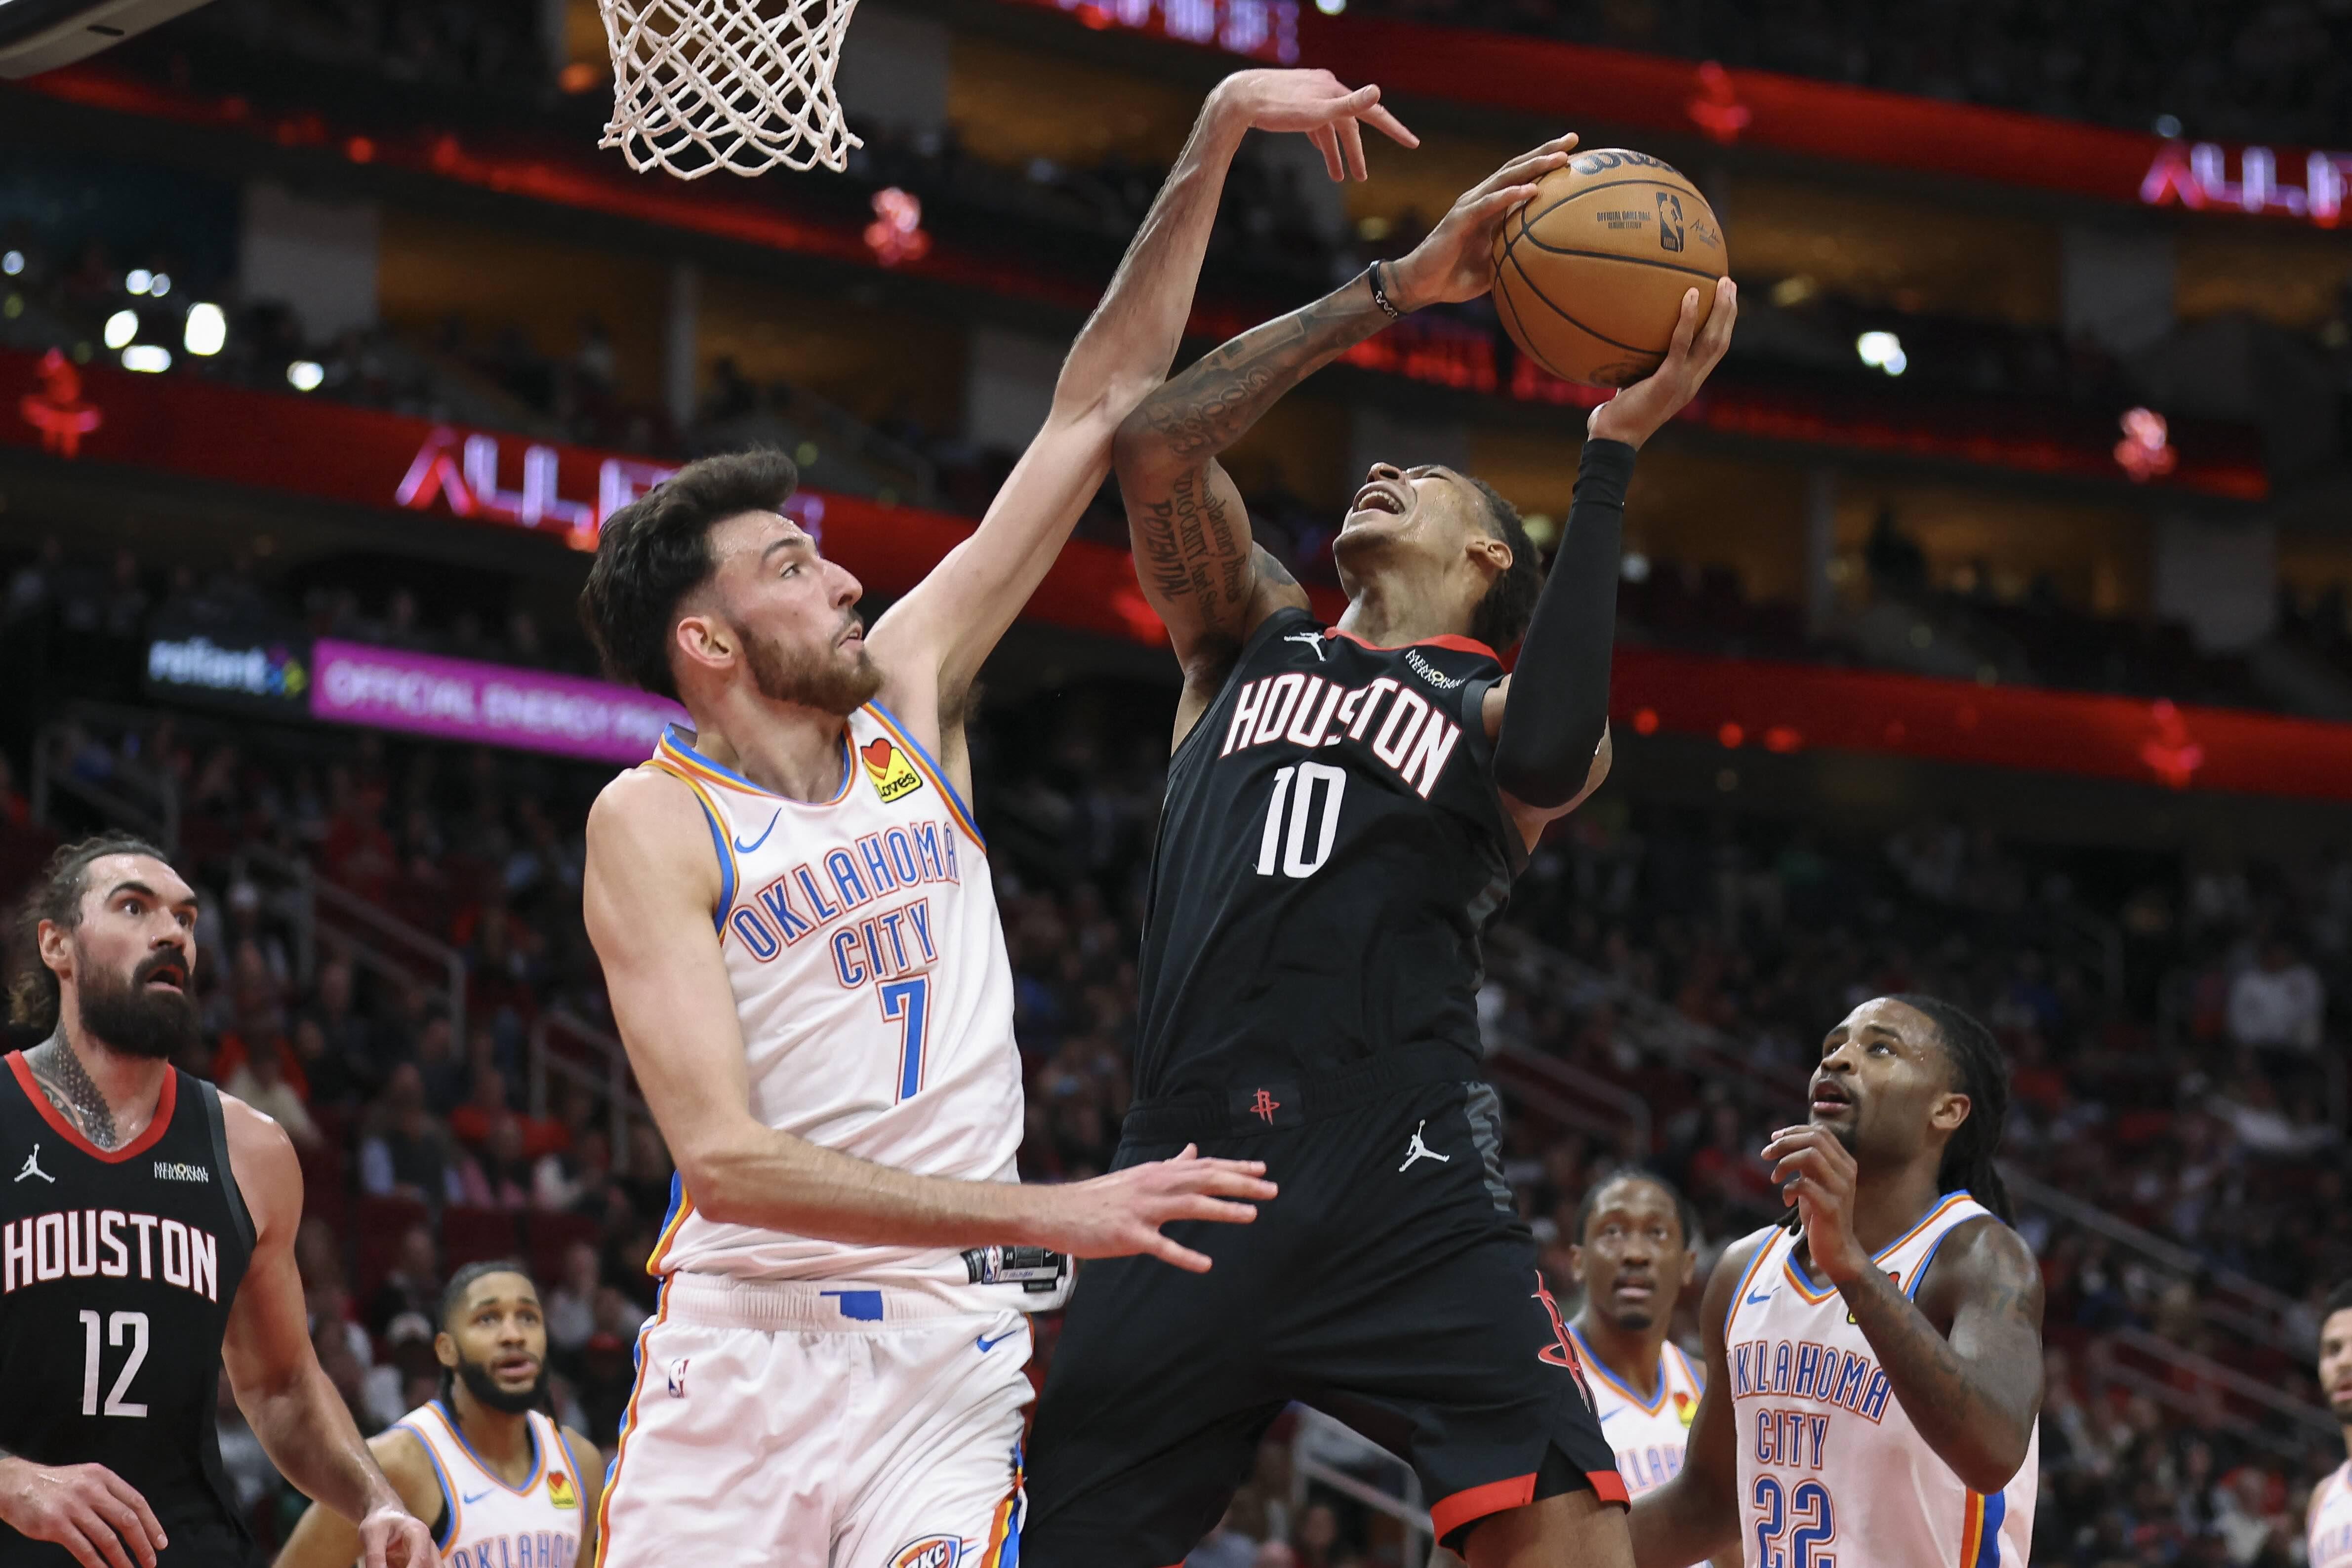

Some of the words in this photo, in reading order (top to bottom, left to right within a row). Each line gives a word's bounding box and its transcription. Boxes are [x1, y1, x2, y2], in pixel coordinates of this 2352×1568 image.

[1219, 673, 1462, 800] HOUSTON
[1256, 761, 1347, 879] 10
[730, 821, 961, 963] OKLAHOMA
[830, 898, 938, 990] CITY
[876, 973, 932, 1105] 7
[2, 1209, 218, 1304] HOUSTON
[79, 1309, 149, 1418] 12
[1755, 1407, 1831, 1470] CITY
[1752, 1473, 1837, 1568] 22
